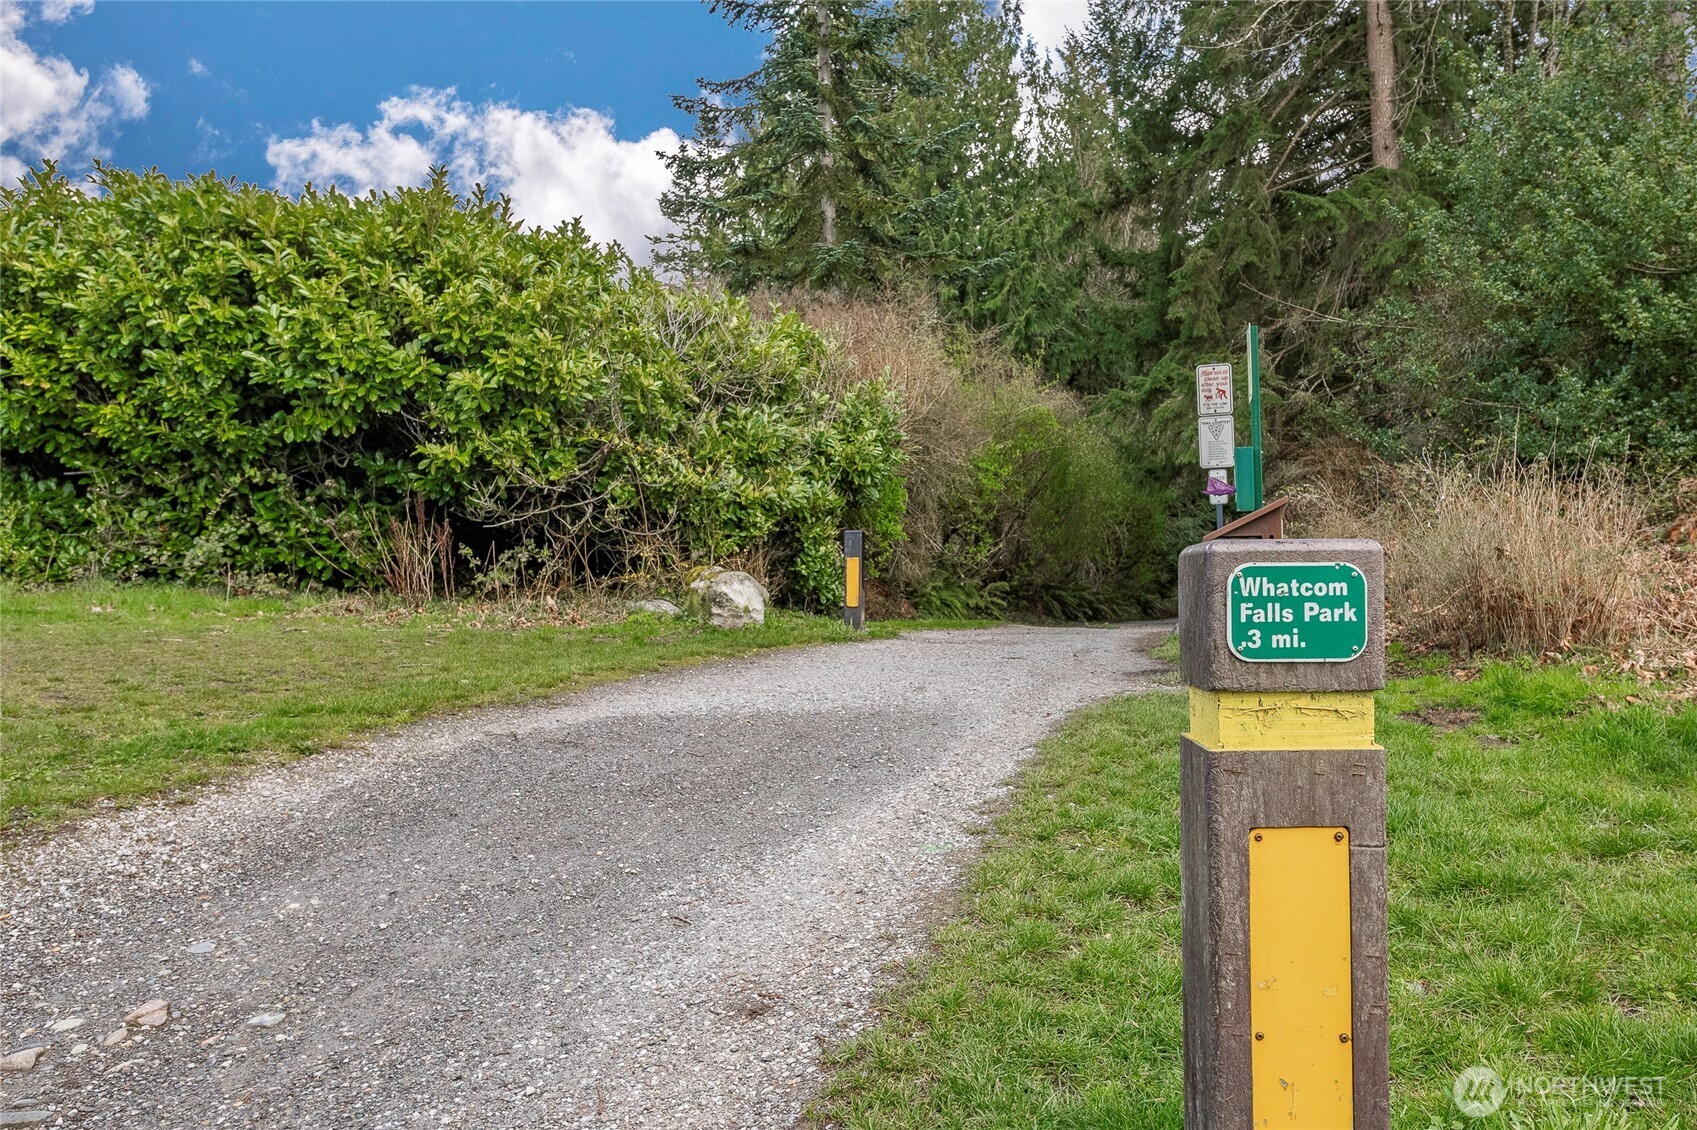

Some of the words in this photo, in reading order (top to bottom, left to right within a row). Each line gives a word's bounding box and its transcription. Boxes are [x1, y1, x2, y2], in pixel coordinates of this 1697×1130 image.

[1239, 577, 1348, 597] Whatcom
[1240, 602, 1294, 623] Falls
[1303, 601, 1358, 622] Park
[1241, 629, 1262, 649] .3
[1271, 628, 1306, 648] mi.
